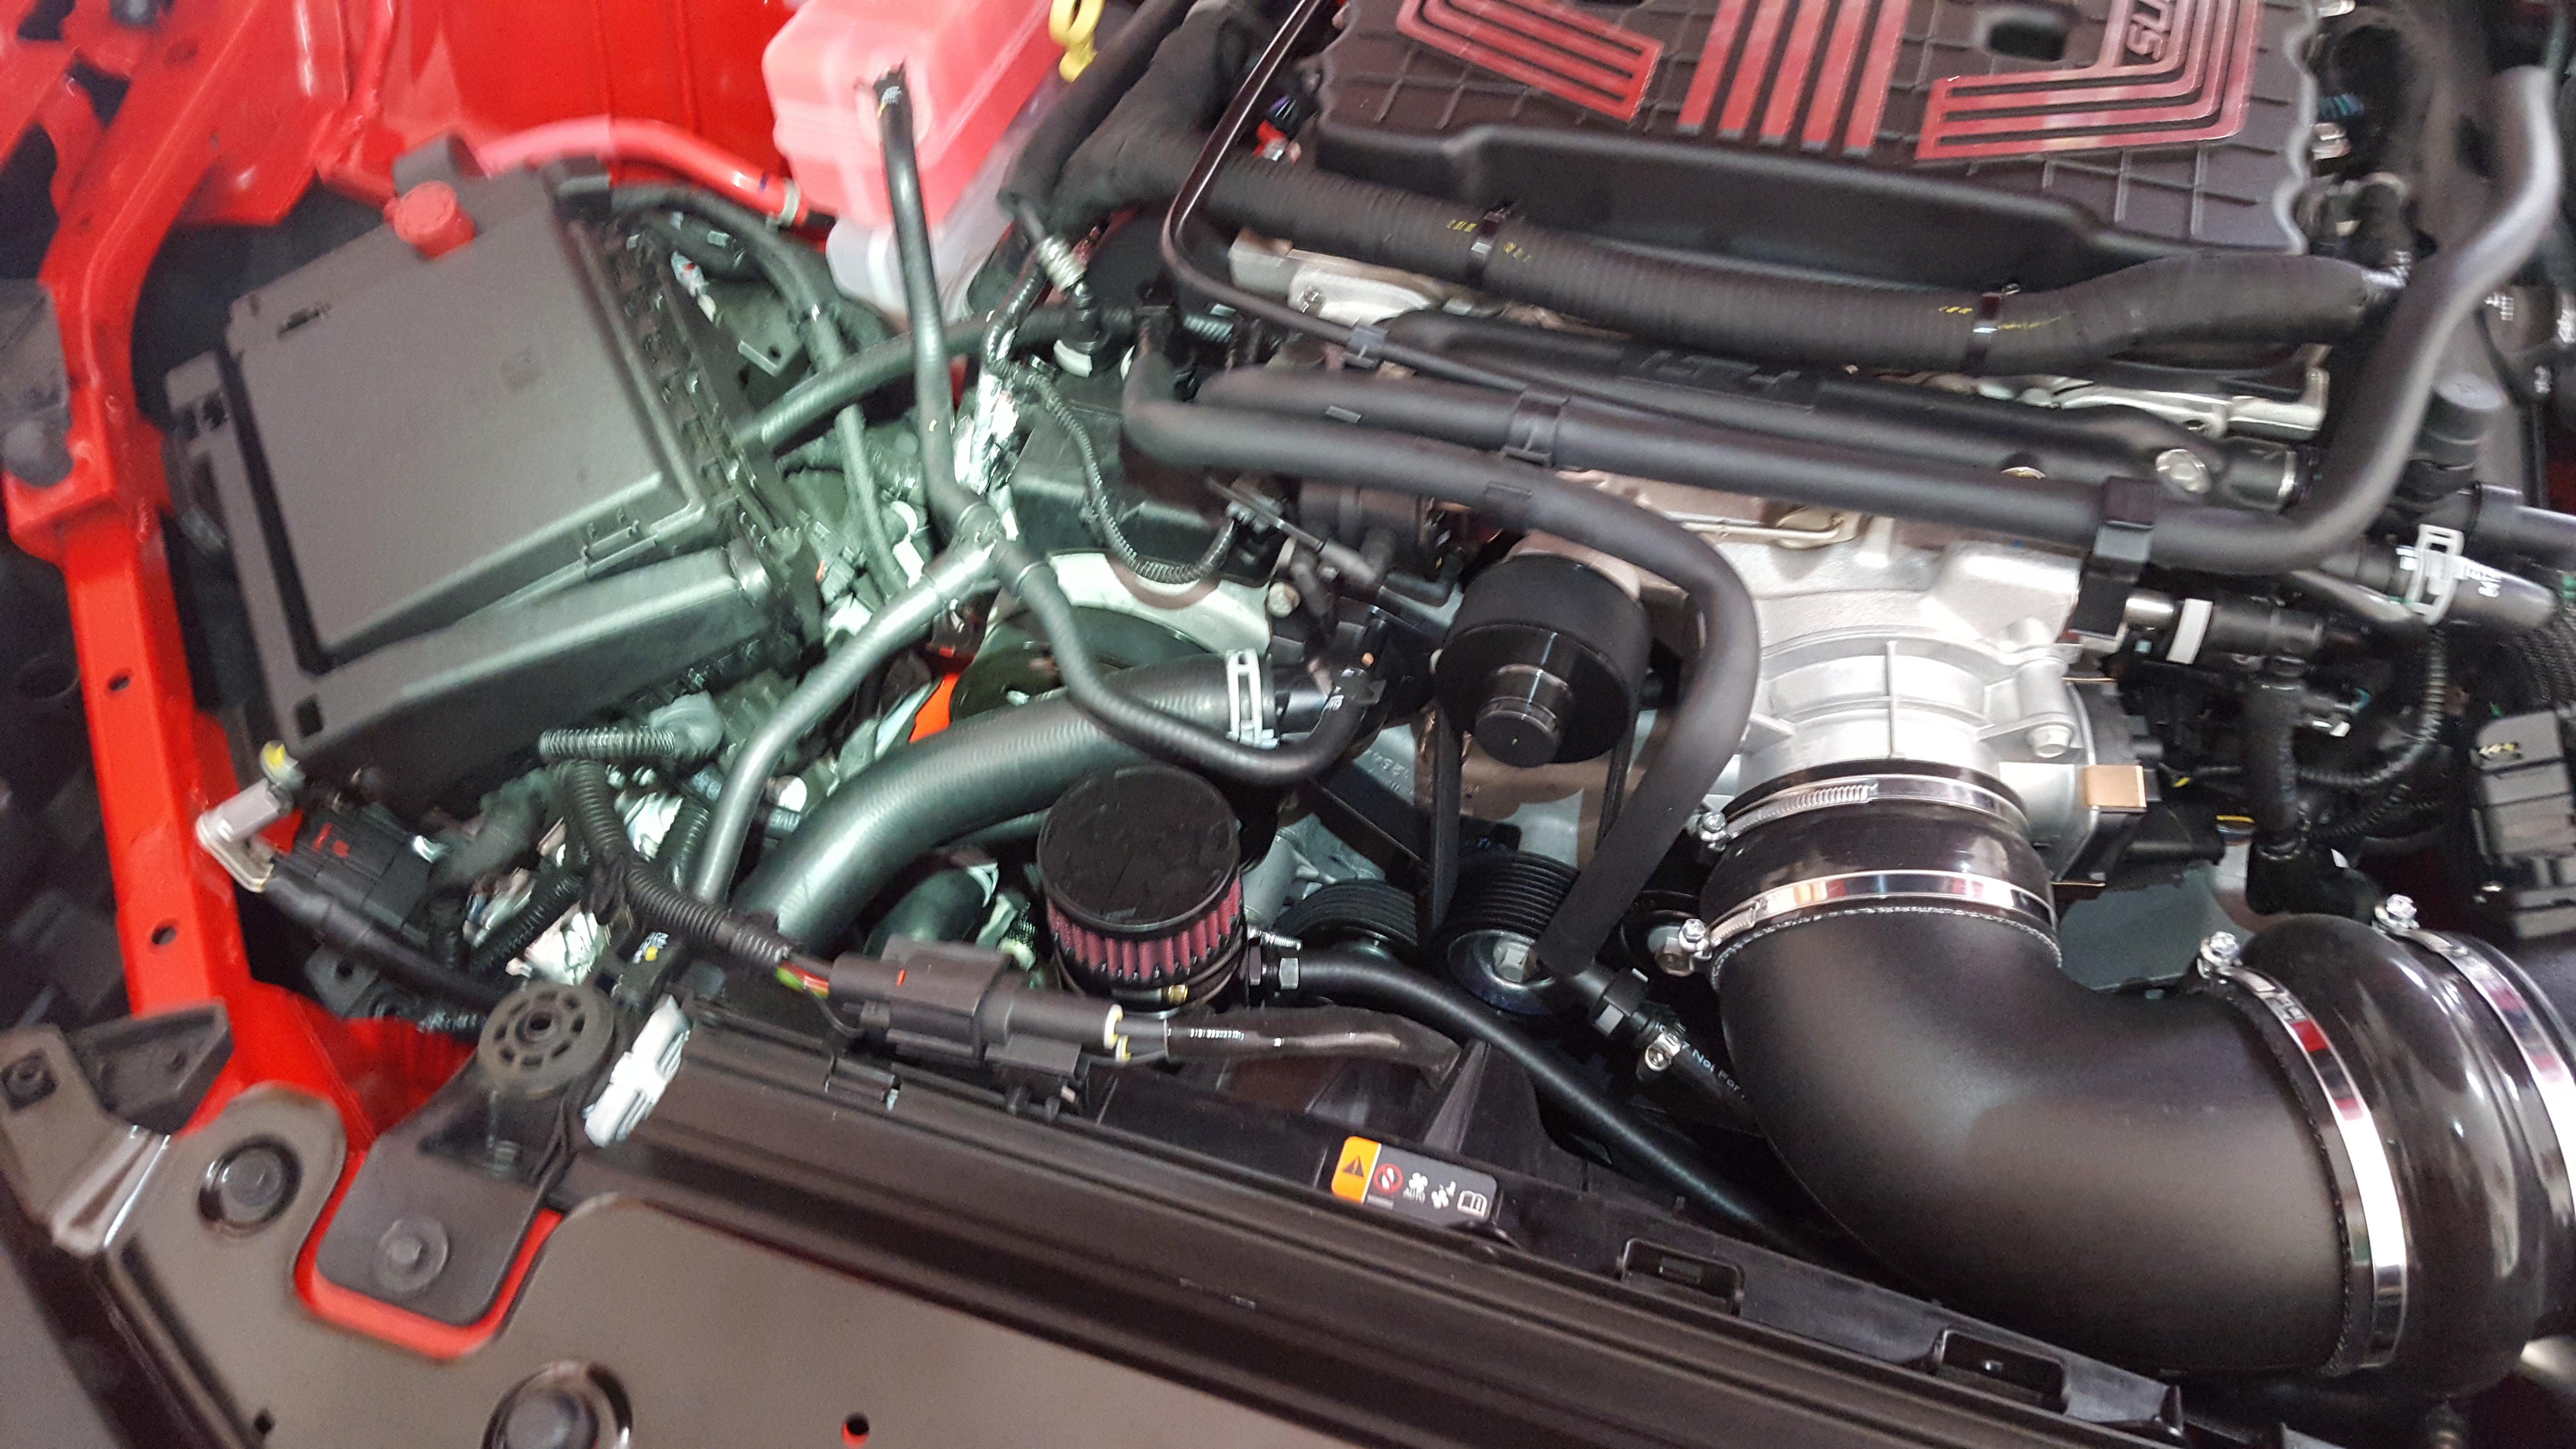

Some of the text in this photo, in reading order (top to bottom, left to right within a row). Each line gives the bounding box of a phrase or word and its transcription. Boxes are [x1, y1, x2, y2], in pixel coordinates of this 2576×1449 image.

[2127, 0, 2171, 61] SU
[1692, 1048, 1715, 1072] Not
[1718, 1069, 1740, 1091] For
